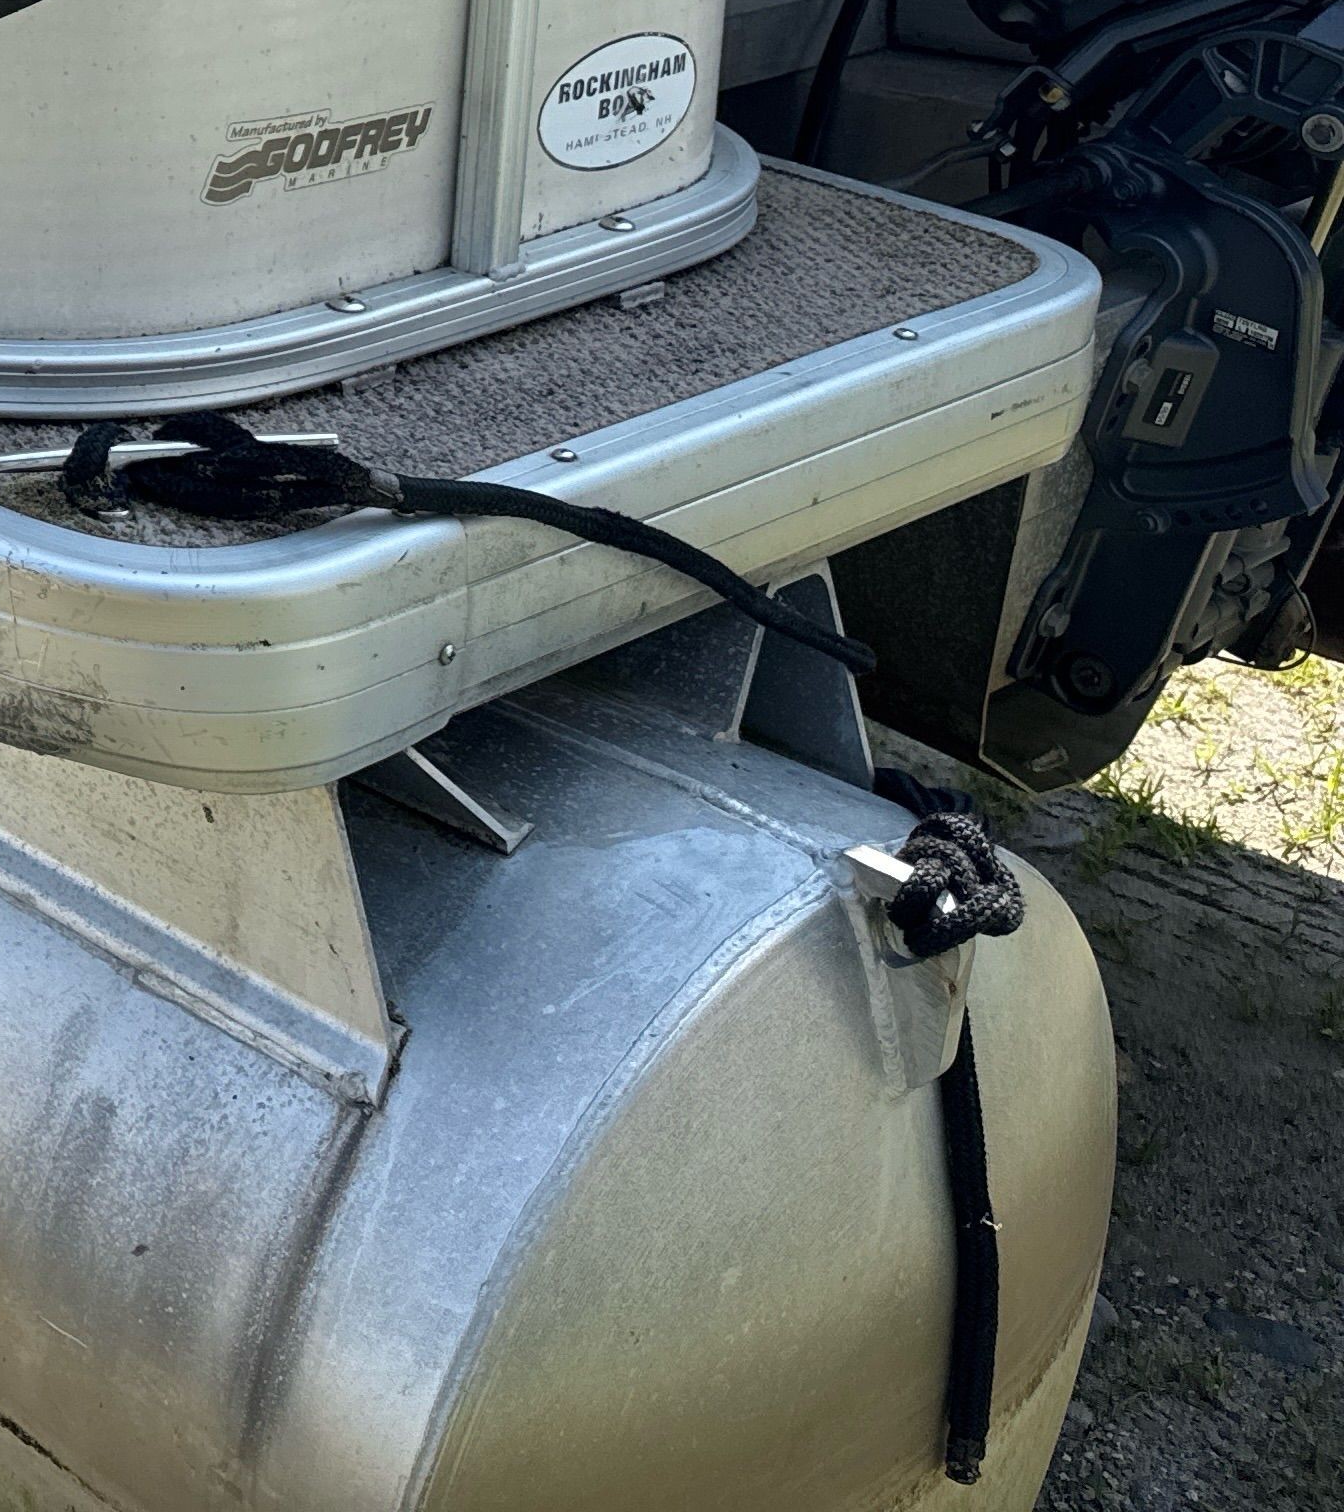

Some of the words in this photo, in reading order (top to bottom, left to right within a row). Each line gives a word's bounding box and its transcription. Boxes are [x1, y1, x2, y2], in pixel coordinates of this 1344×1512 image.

[558, 52, 687, 104] ROCKINGHAM
[230, 117, 312, 139] Manufactured
[314, 114, 328, 128] by
[656, 114, 672, 128] NH
[258, 107, 433, 179] GODFREY
[287, 155, 388, 187] MARINE
